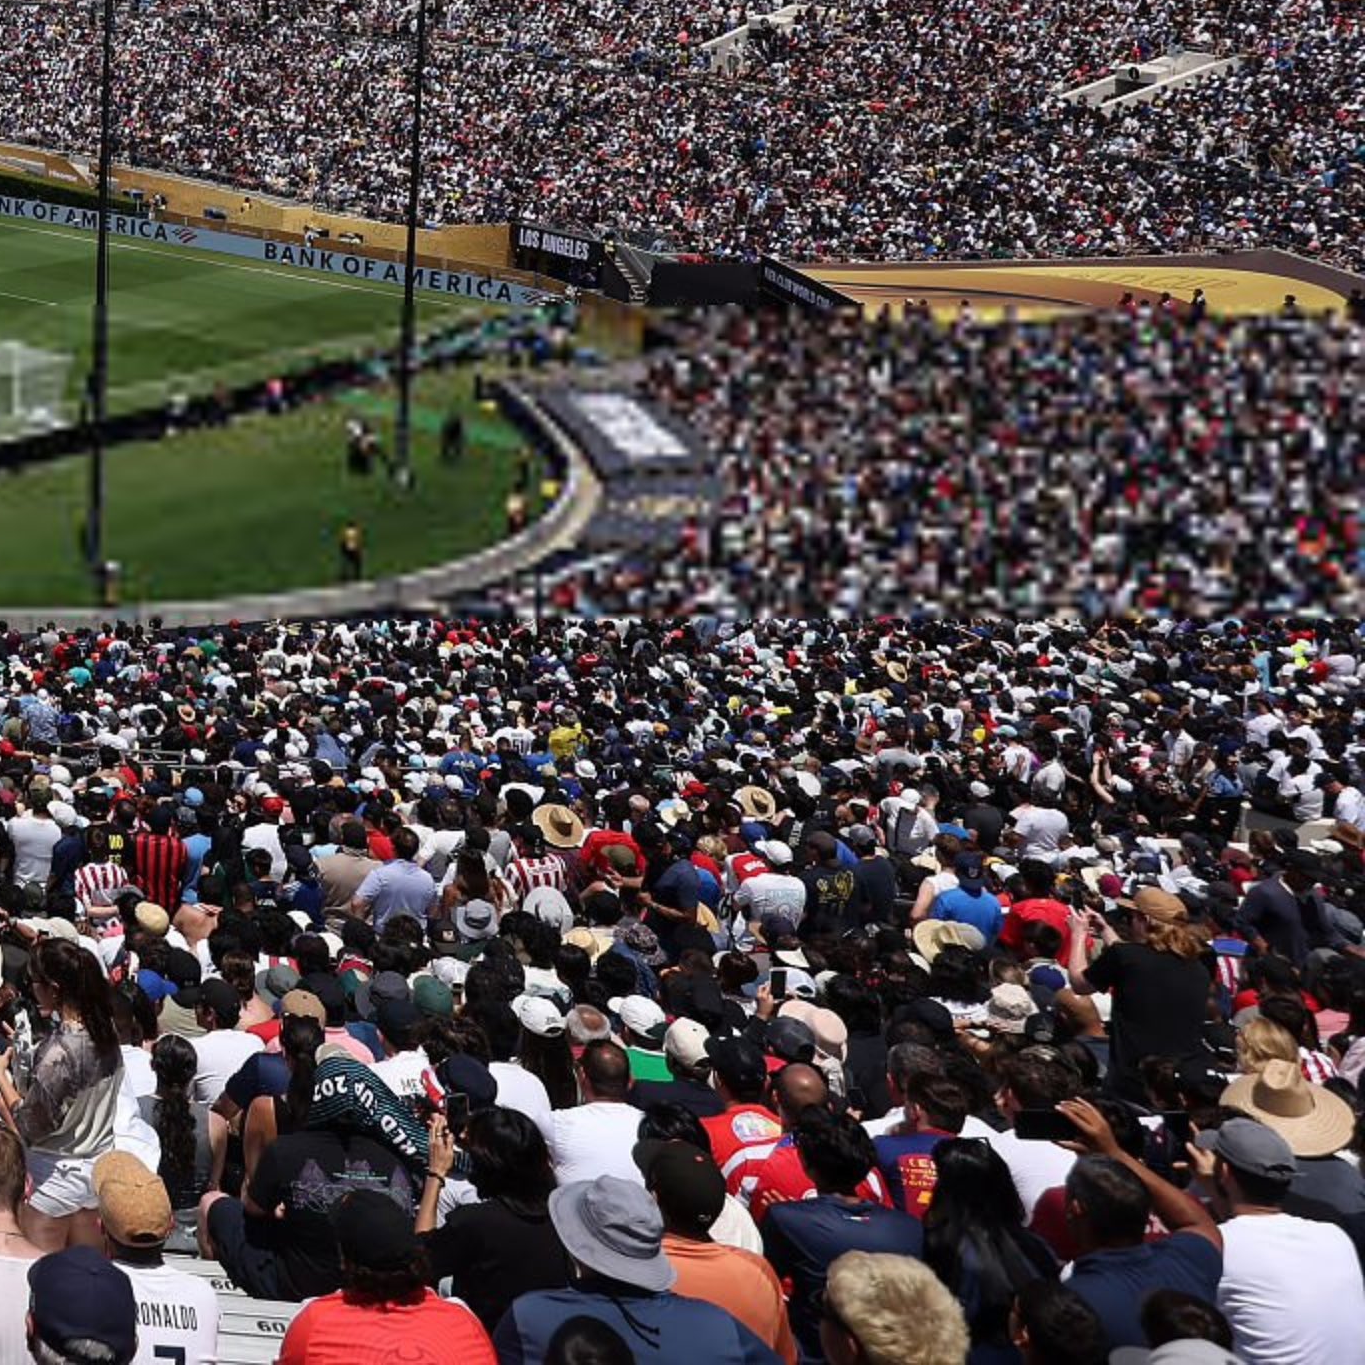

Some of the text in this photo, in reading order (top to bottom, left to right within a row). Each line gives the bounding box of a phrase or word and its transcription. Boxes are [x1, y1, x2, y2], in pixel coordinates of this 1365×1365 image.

[32, 203, 58, 223] OF
[66, 208, 168, 241] AMERICA
[519, 228, 589, 261] LOS ANGELES
[265, 242, 512, 303] BANK OF AMERICA
[257, 1320, 285, 1332] 60
